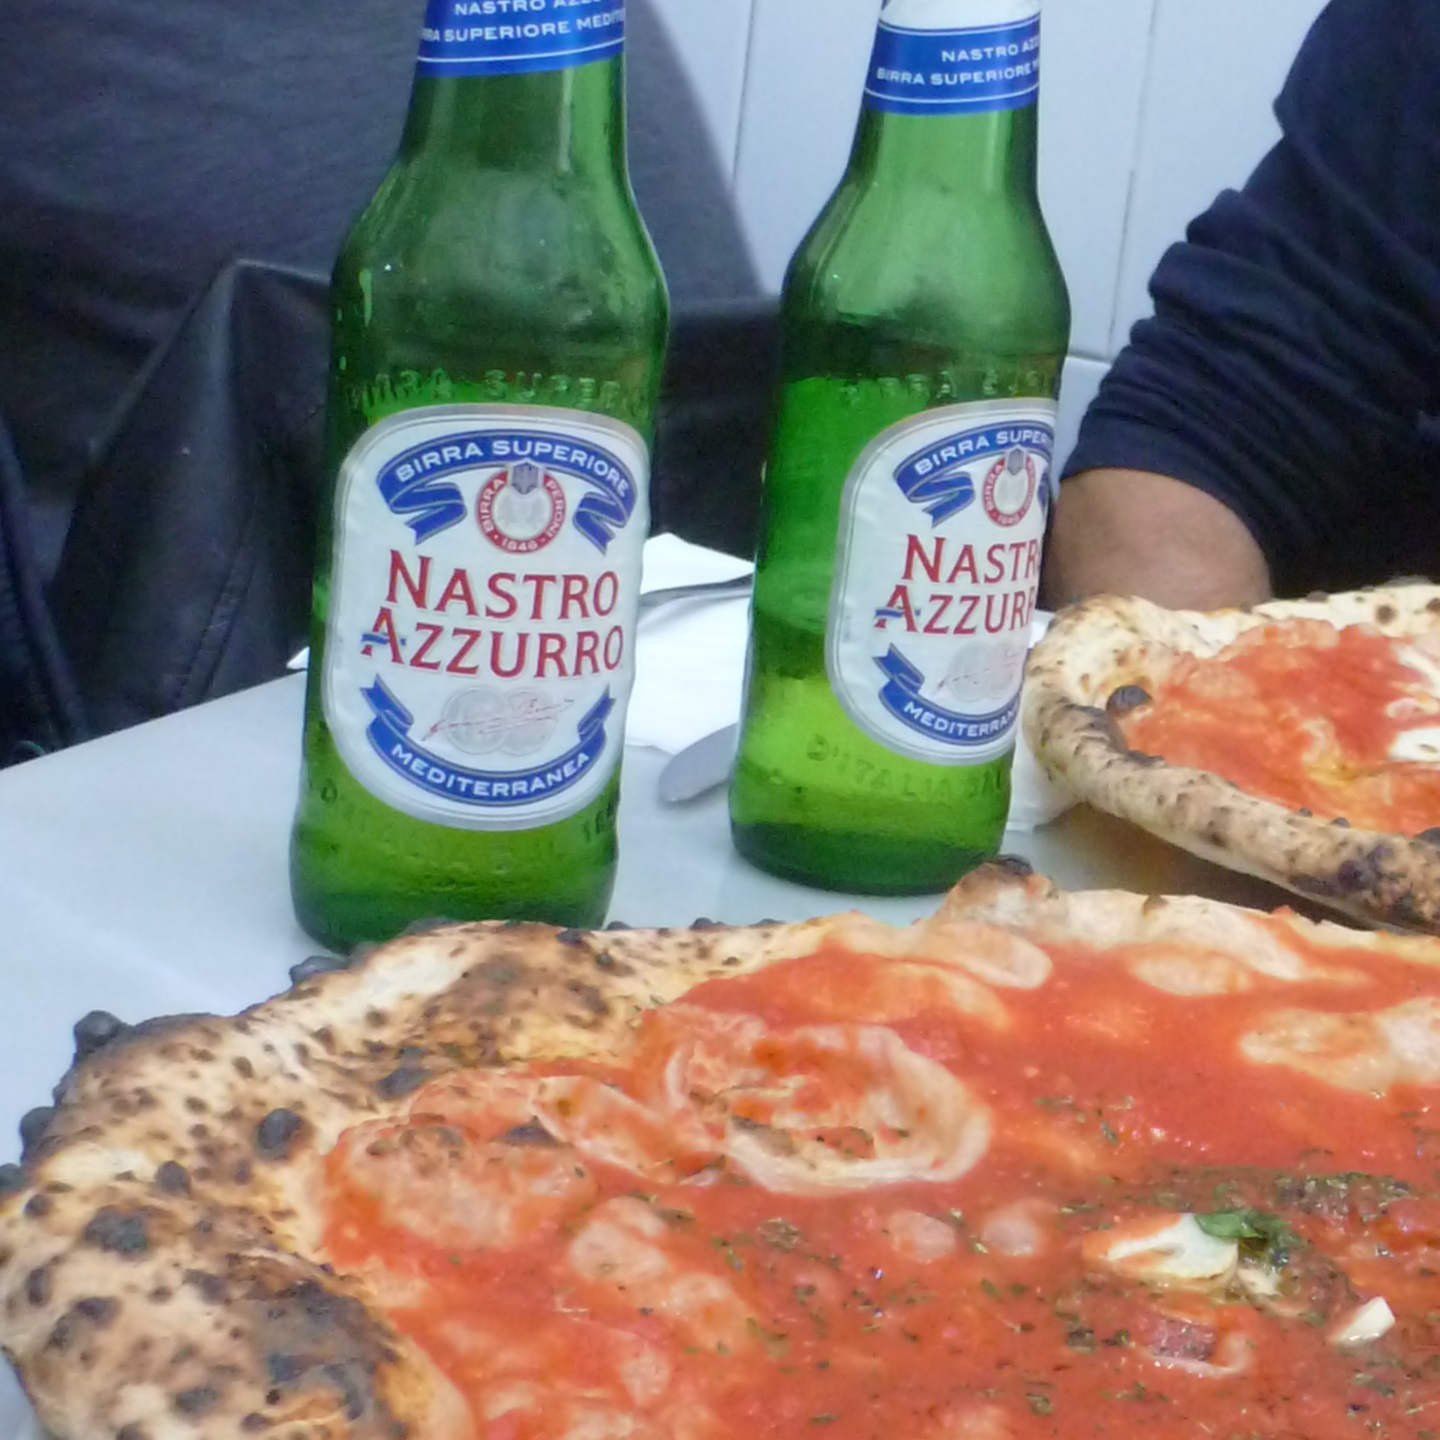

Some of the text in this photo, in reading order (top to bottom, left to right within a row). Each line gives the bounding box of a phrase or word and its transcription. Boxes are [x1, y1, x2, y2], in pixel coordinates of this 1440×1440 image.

[444, 21, 571, 43] SUPERIORE
[941, 44, 1018, 63] NASTRO
[876, 67, 925, 86] BIRRA
[930, 63, 1032, 87] SUPERIORE
[395, 439, 630, 498] BIRRA SUPERIORE
[914, 428, 1049, 477] BIRRA SUPER
[384, 548, 620, 620] NASTRO
[901, 533, 1040, 584] NASTR
[873, 584, 1036, 635] AZZUR
[360, 605, 625, 679] AZZURRO
[391, 743, 590, 798] MEDITERRANEA
